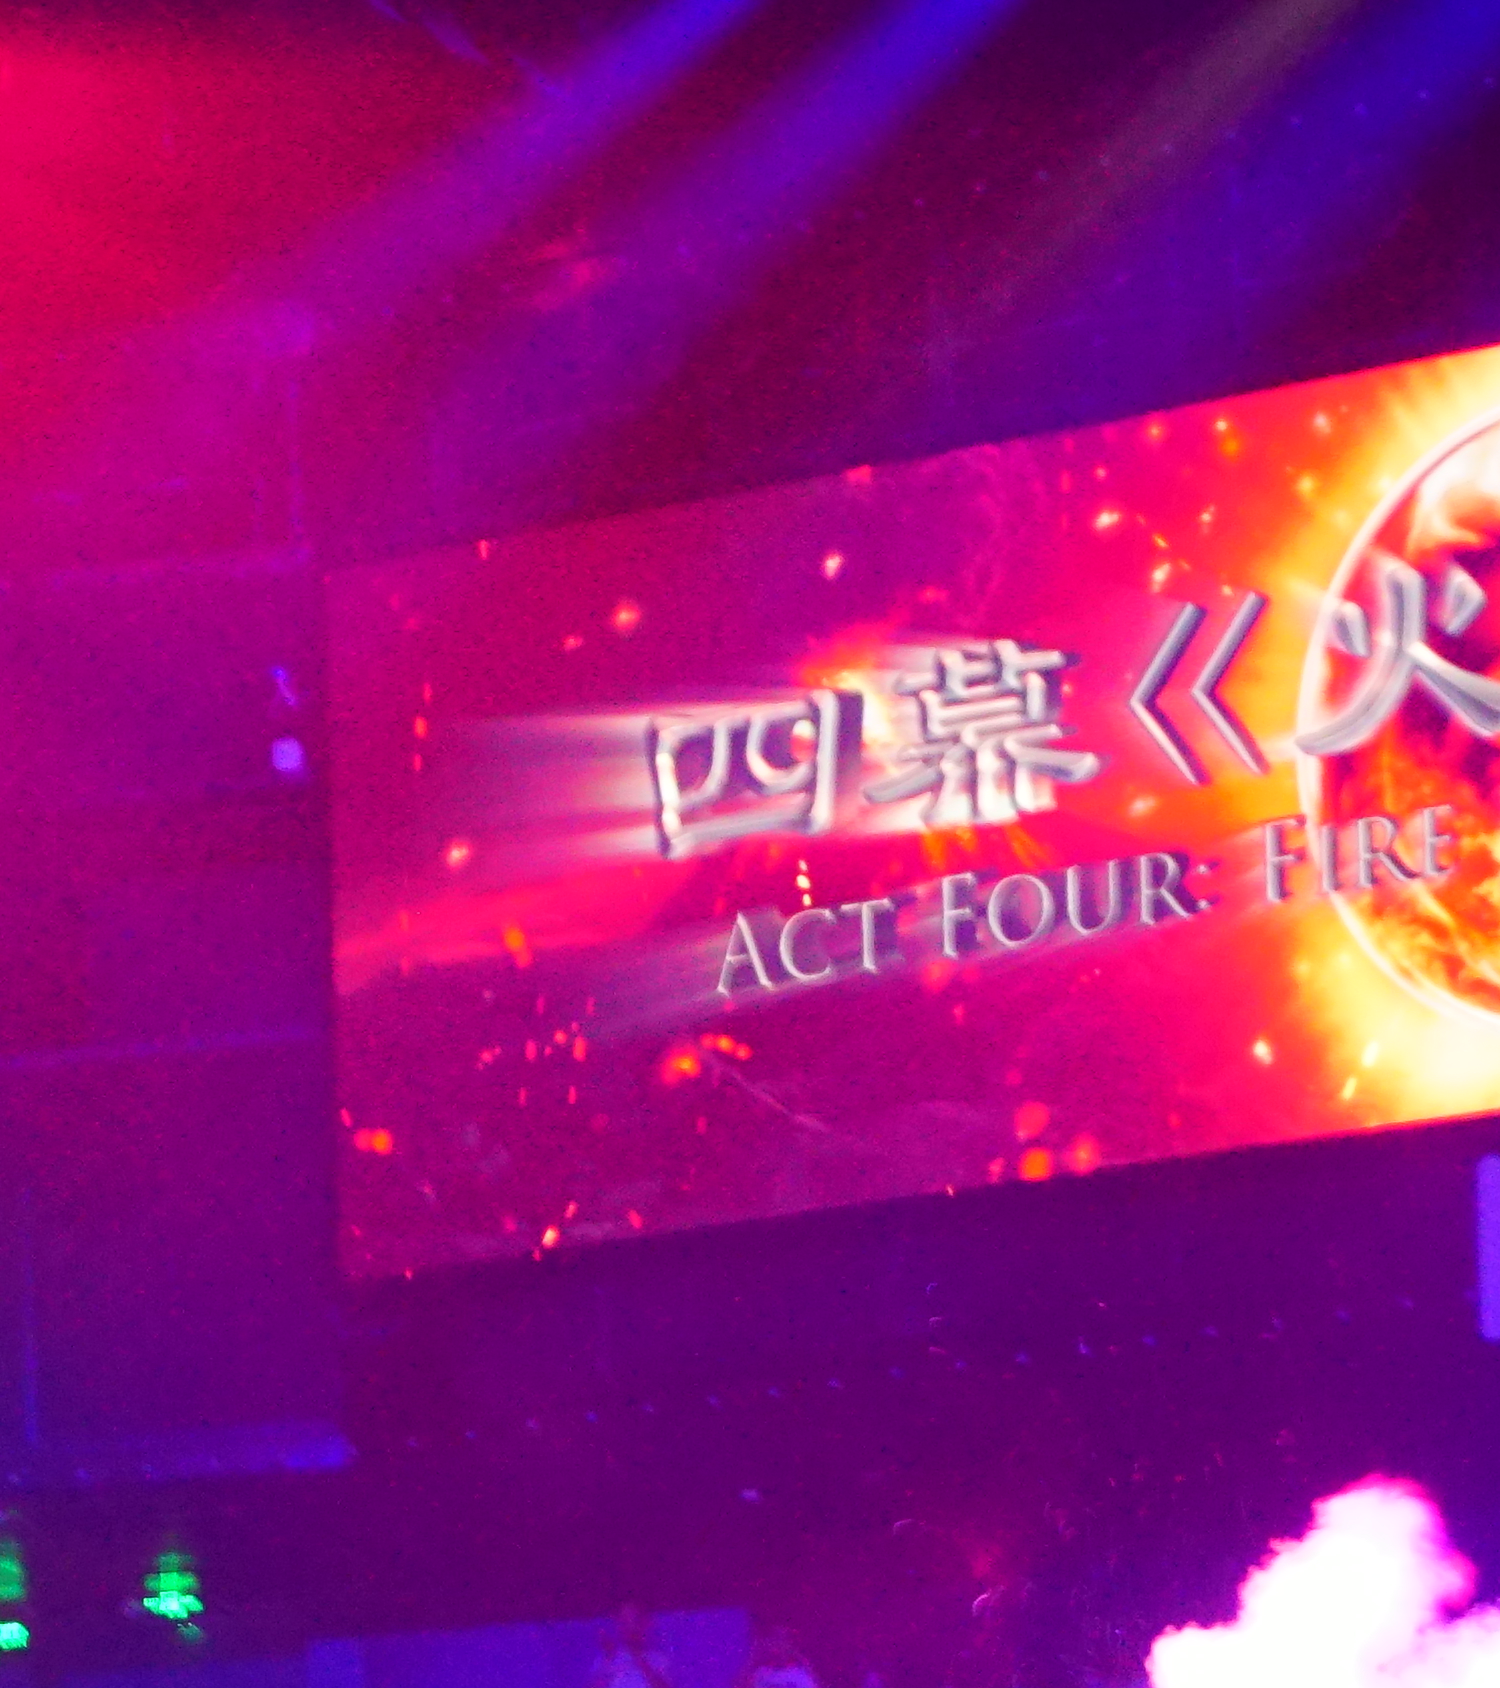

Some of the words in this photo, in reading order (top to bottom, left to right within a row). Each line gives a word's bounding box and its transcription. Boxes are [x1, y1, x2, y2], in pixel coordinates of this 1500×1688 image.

[715, 897, 895, 996] ACT
[939, 850, 1212, 957] FOUR:
[1262, 806, 1457, 902] FIRE
